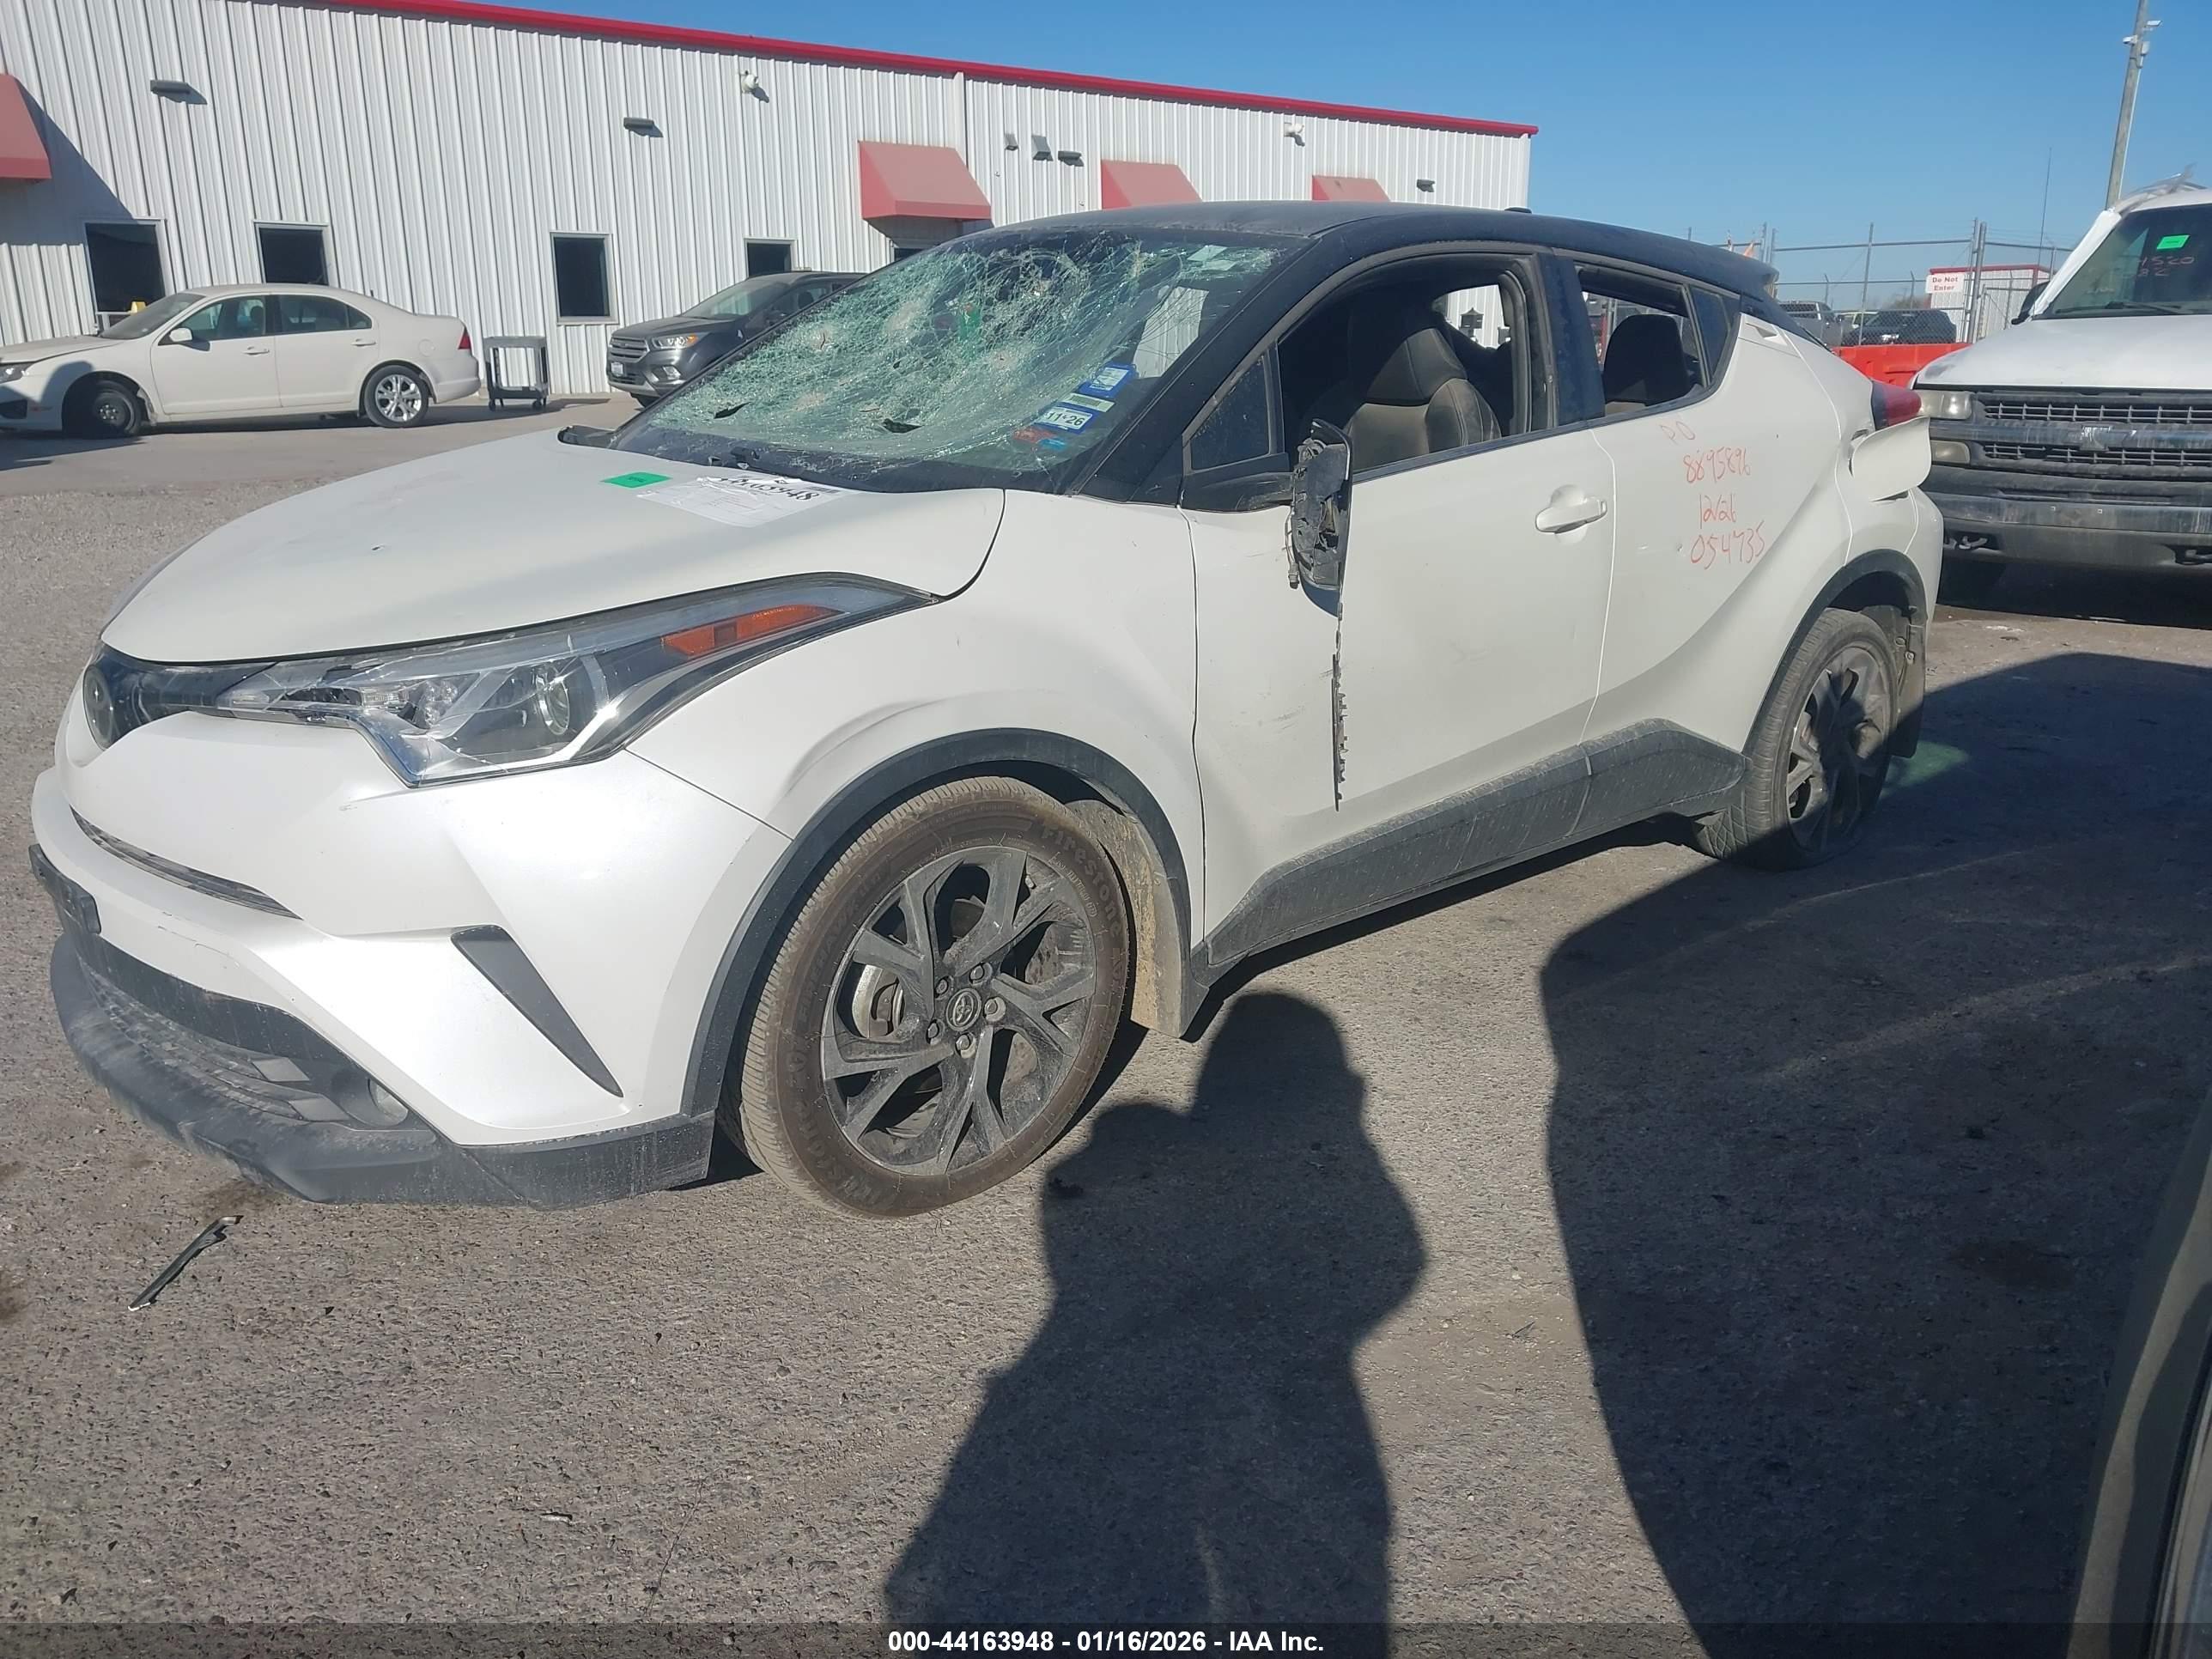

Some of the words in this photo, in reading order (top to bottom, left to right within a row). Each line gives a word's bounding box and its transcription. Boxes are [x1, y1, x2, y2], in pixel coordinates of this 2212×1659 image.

[1047, 411, 1060, 422] 11
[1066, 415, 1085, 427] 26
[1690, 520, 1765, 569] 054735
